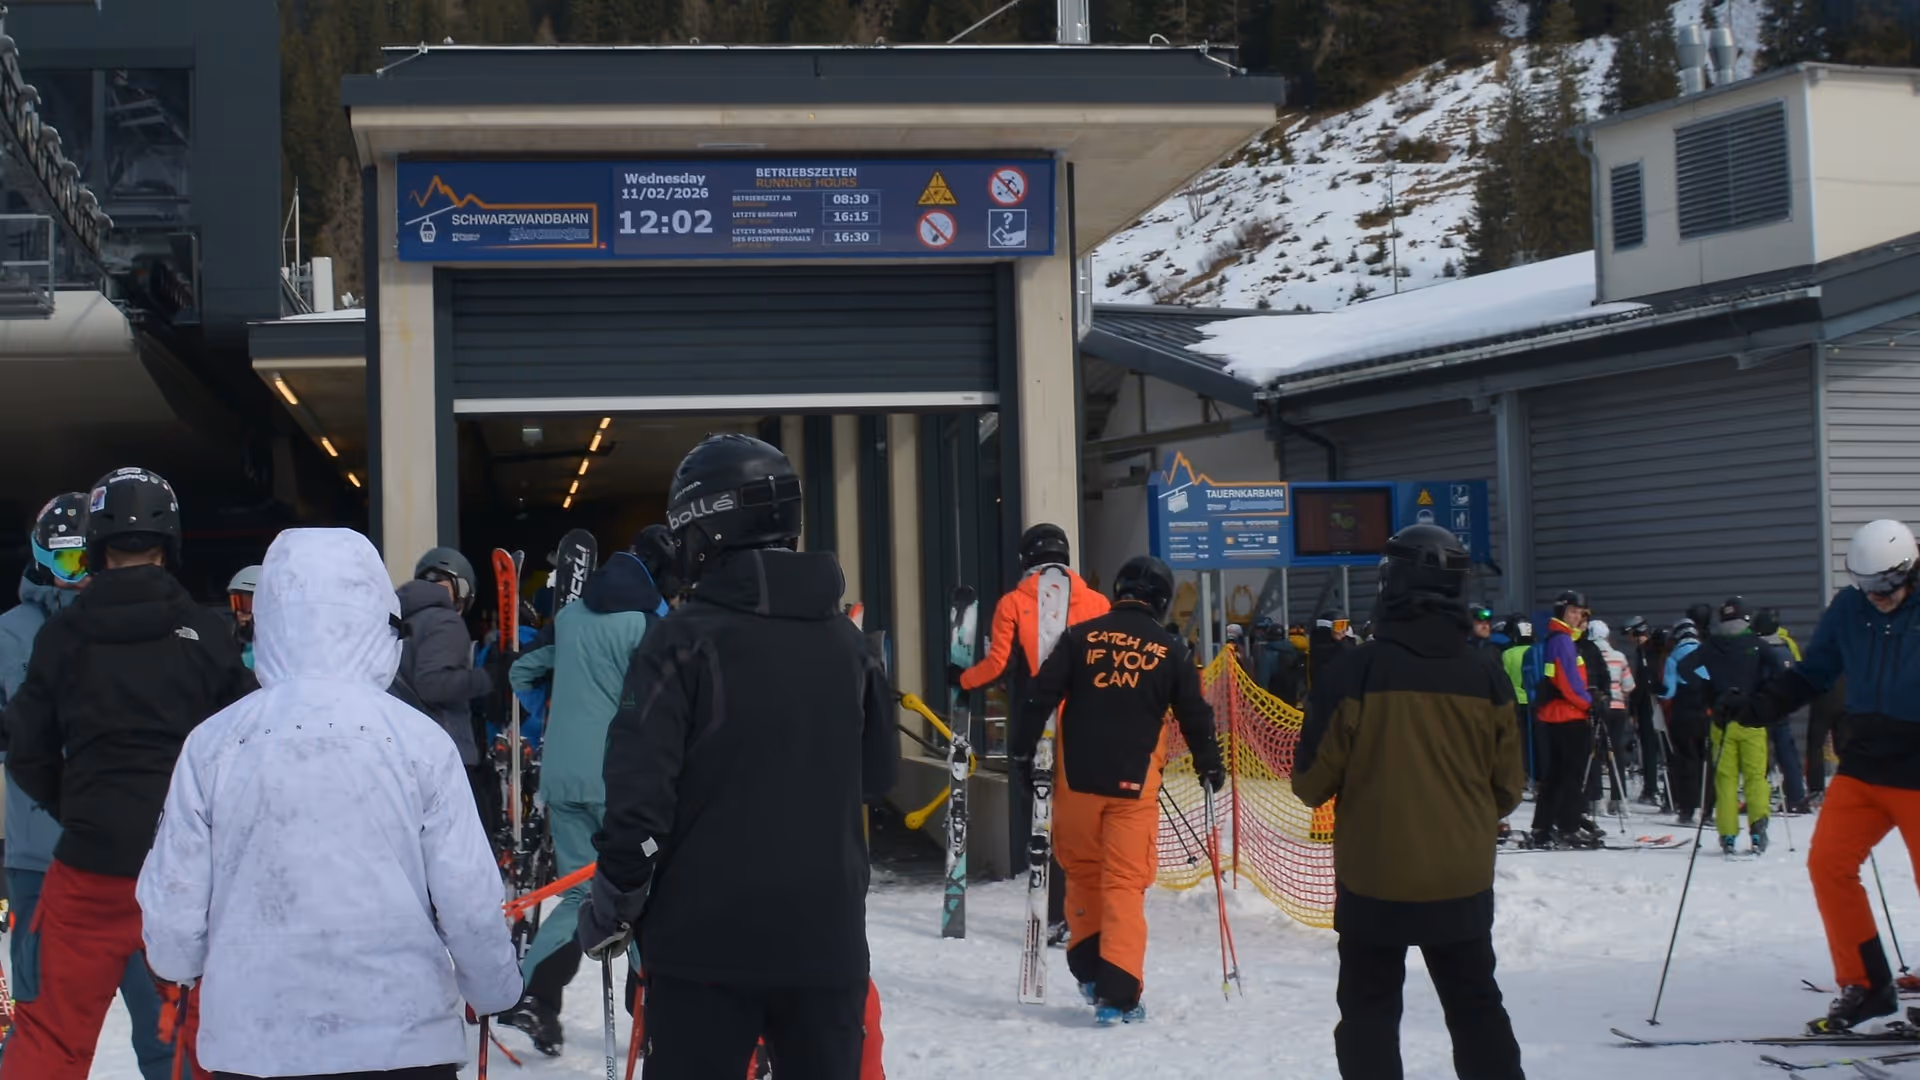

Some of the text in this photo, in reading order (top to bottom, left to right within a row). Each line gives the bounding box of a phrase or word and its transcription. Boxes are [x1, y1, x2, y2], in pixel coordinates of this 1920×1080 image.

[756, 168, 857, 177] BETRIEBSZEITEN
[624, 172, 706, 186] Wednesday
[756, 178, 858, 188] RUNNING HOURS
[622, 187, 709, 200] 11/02/2026
[833, 194, 869, 204] 08:30
[451, 213, 589, 225] SCHWARZWANDBAHN
[619, 209, 713, 234] 12:02
[834, 211, 869, 221] 16:15
[834, 232, 870, 242] 16:30
[1205, 489, 1283, 498] TAUERNKARBAHN
[1086, 630, 1169, 659] CATCH ME
[1086, 648, 1160, 671] IF YOU
[1094, 671, 1139, 689] CAN
